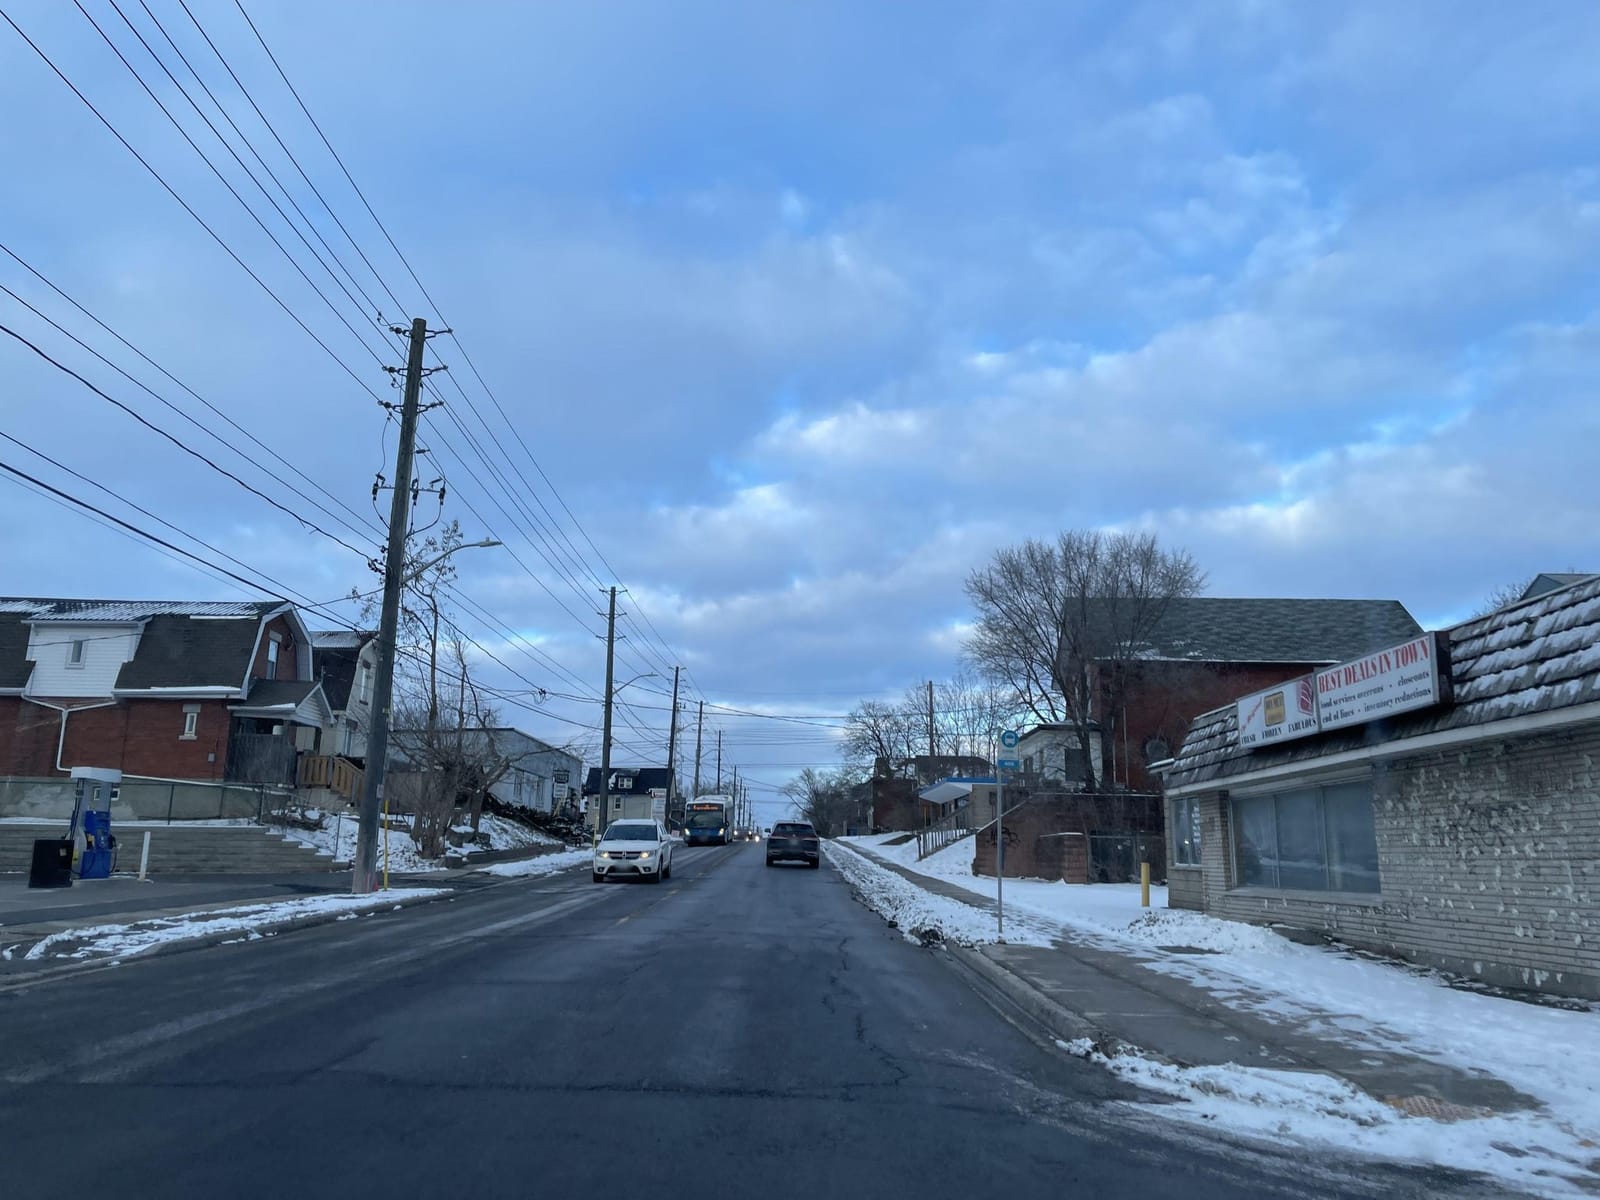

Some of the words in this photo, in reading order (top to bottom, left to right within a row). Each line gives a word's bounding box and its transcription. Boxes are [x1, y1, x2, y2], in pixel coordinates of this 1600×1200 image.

[1318, 670, 1342, 694] BEST
[1344, 657, 1377, 686] DEALS
[1378, 651, 1391, 674] IN
[1393, 638, 1429, 669] TOWN
[1333, 693, 1356, 705] services
[1394, 688, 1431, 704] reductions
